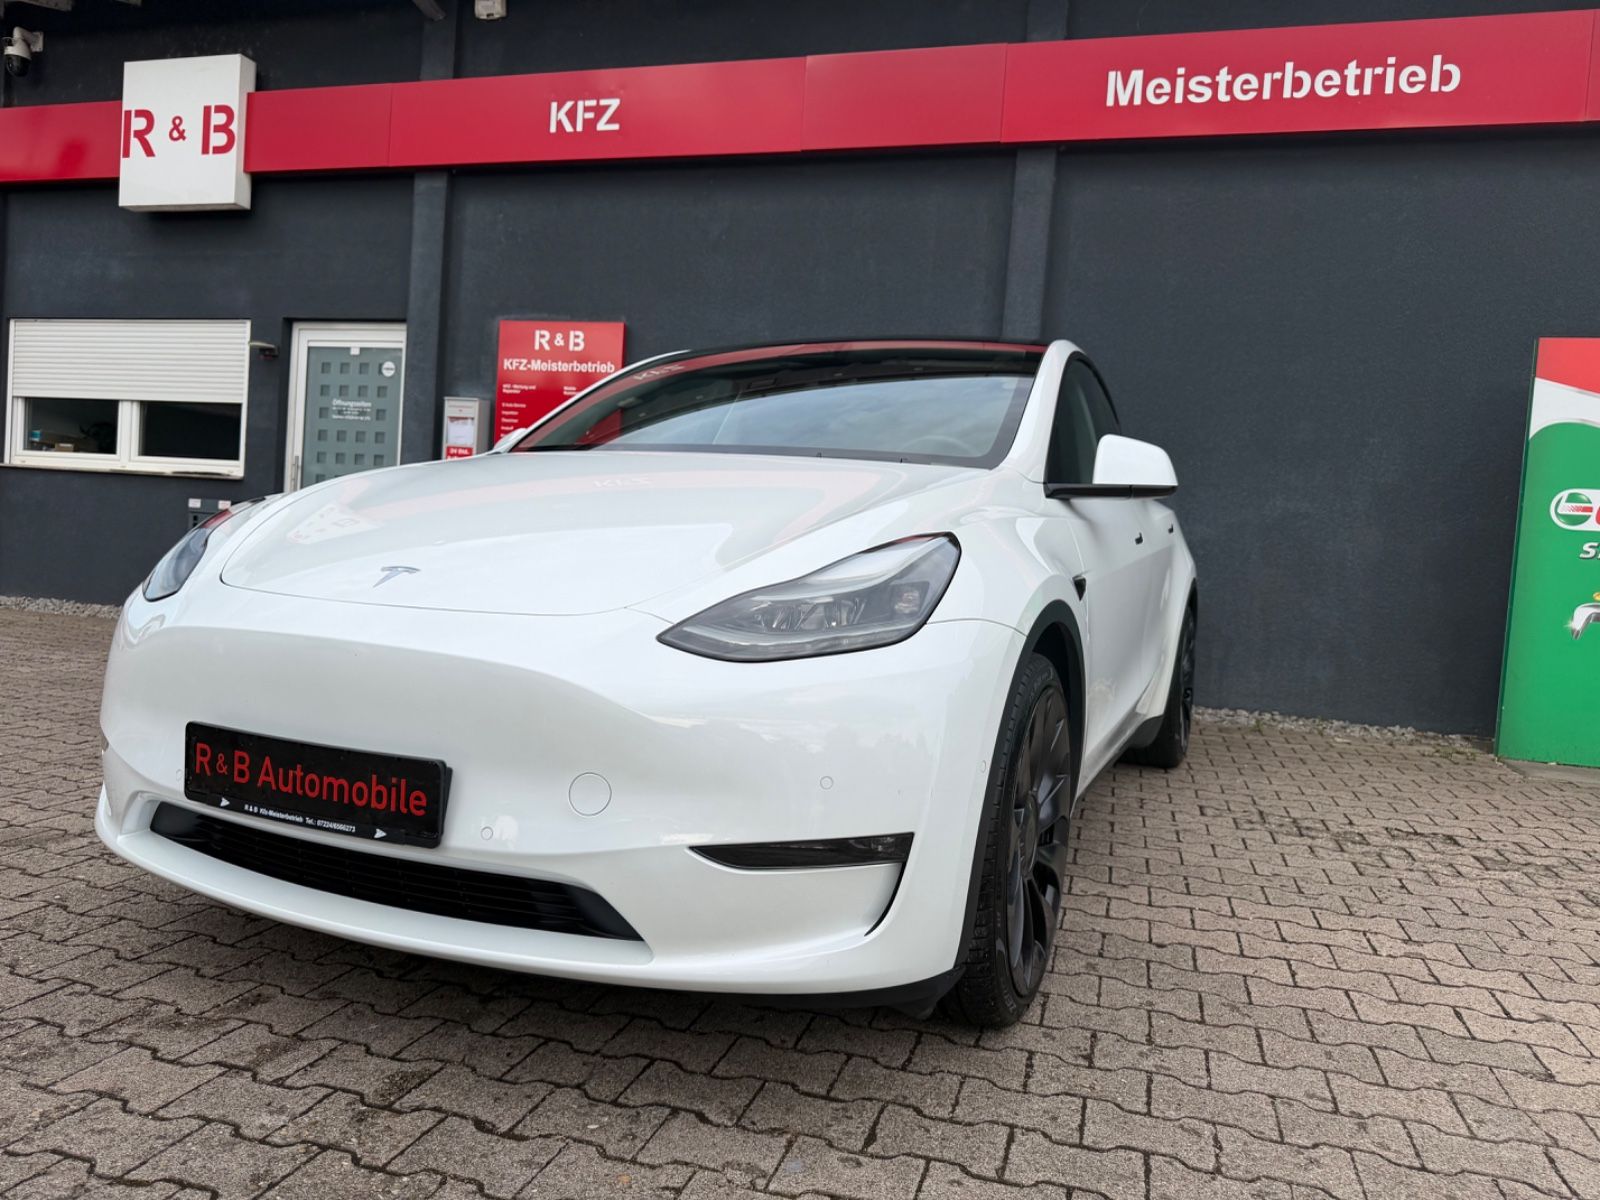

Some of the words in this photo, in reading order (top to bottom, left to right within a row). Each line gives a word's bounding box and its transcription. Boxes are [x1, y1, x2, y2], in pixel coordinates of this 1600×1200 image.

[1105, 54, 1462, 108] Meisterbetrieb
[122, 109, 156, 158] R
[168, 115, 187, 142] &
[201, 104, 236, 155] B
[549, 98, 621, 133] KFZ
[534, 329, 551, 351] R
[554, 332, 565, 346] &
[568, 330, 585, 352] B
[503, 358, 615, 373] KFZ-Meisterbetrieb
[195, 742, 212, 777] R
[216, 752, 229, 775] &
[234, 750, 251, 784] B
[257, 755, 427, 817] Automobile
